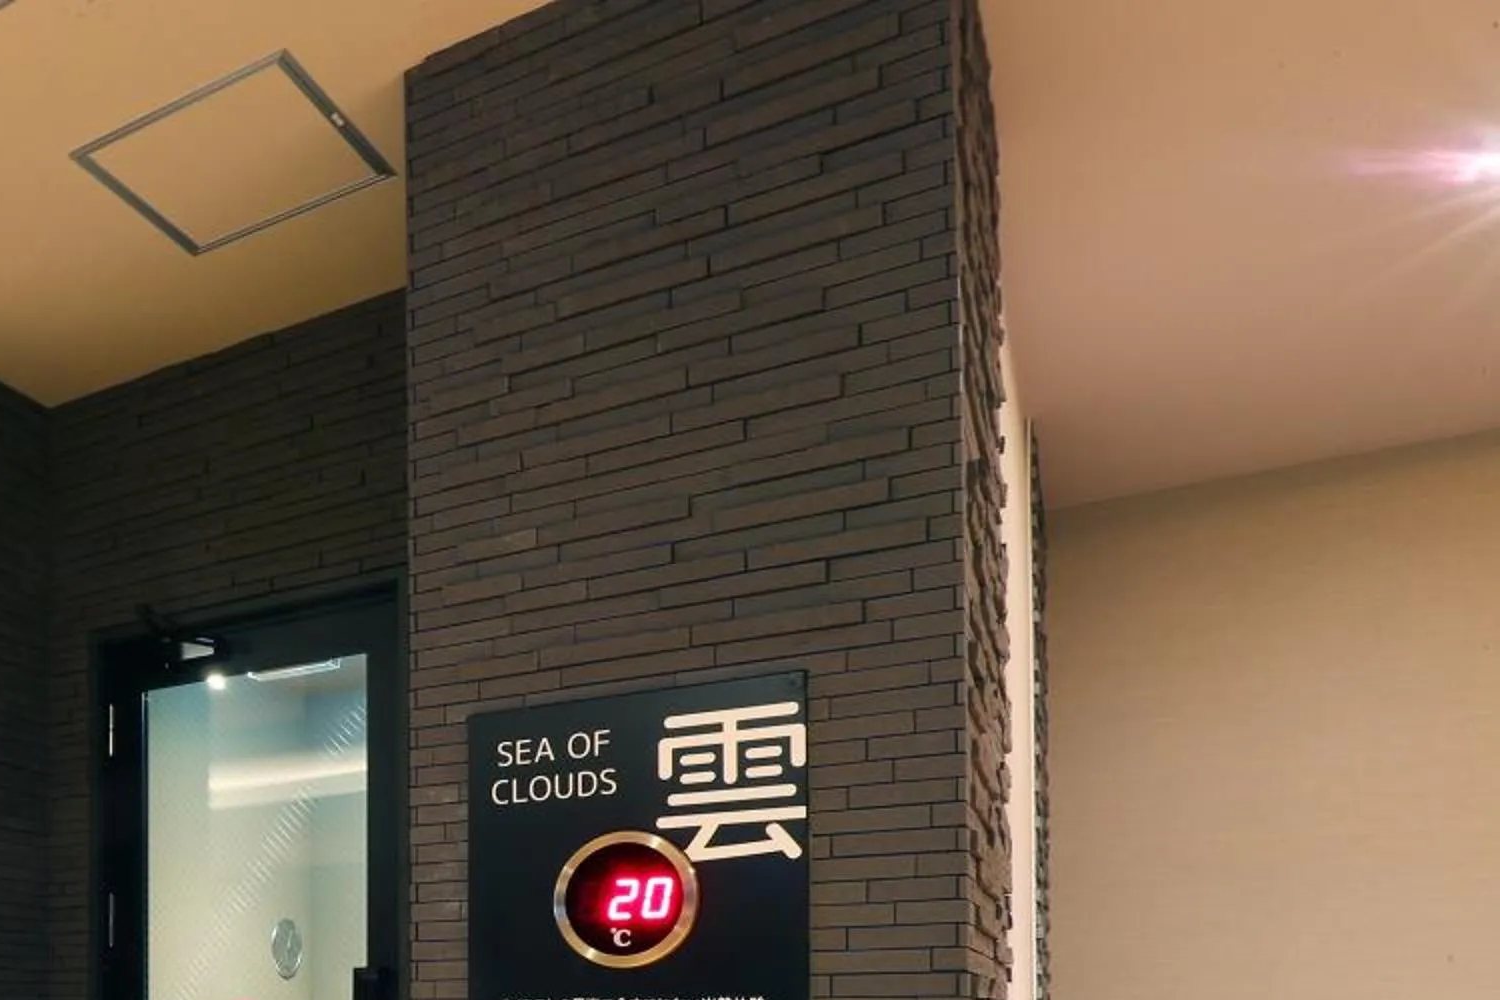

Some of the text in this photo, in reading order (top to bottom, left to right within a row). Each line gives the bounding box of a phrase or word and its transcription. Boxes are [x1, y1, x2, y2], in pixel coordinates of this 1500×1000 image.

[497, 729, 612, 767] SEA OF
[491, 768, 618, 805] CLOUDS
[655, 701, 808, 863] 雲
[607, 876, 674, 921] 20
